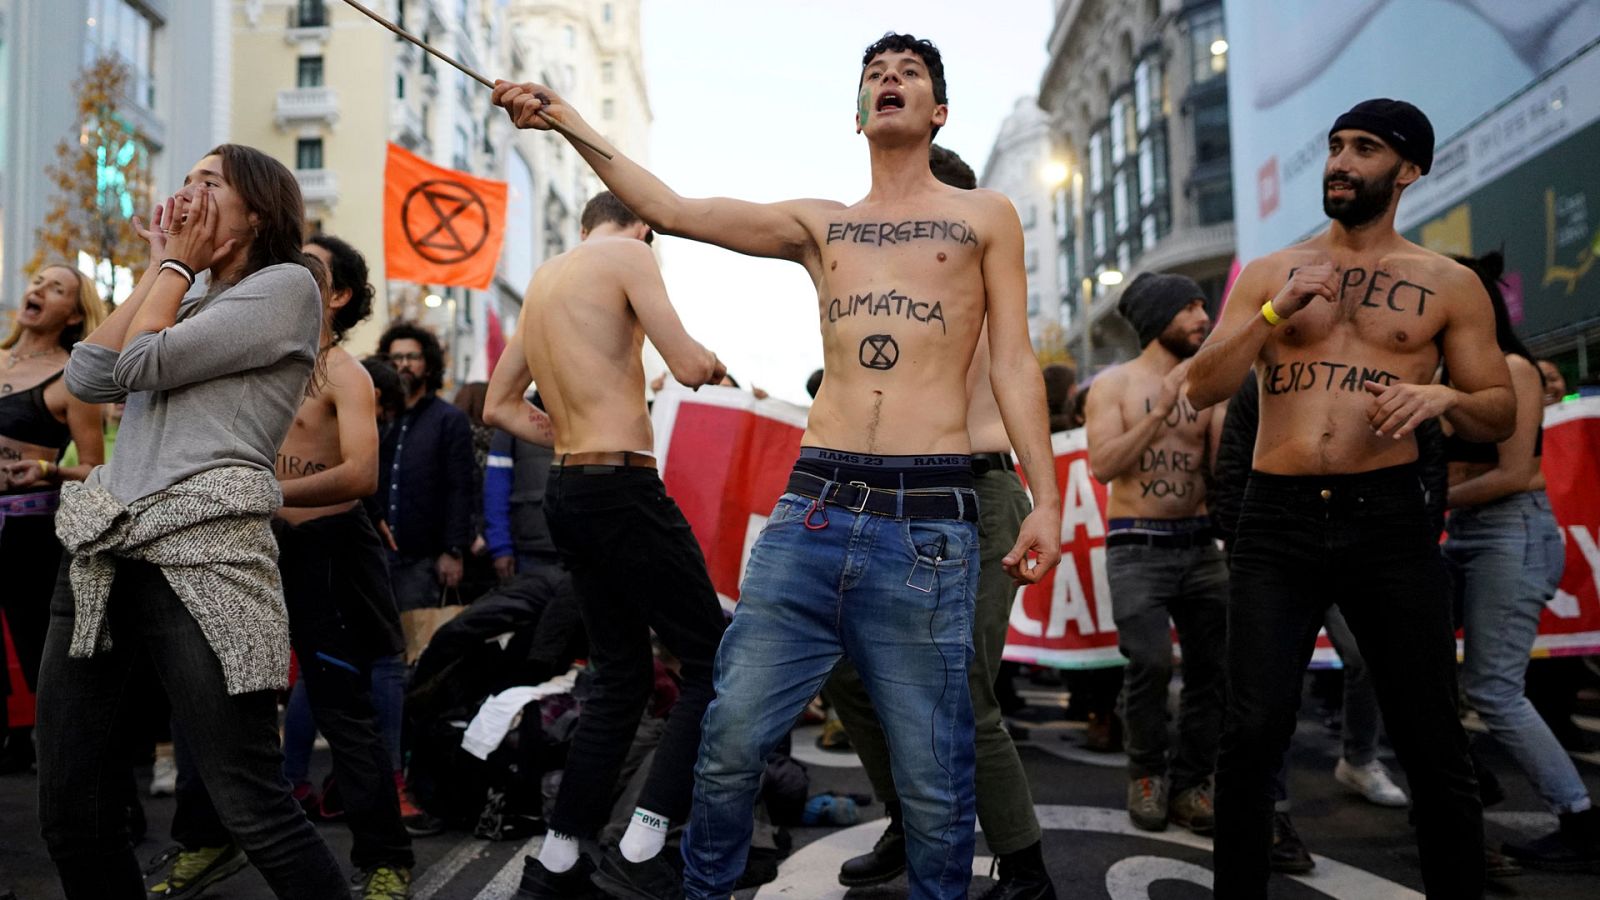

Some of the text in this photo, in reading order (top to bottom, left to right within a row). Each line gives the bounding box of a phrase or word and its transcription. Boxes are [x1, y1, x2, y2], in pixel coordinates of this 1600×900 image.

[1288, 267, 1436, 316] PECT
[1145, 397, 1199, 428] OW
[819, 450, 884, 466] RAMS 23
[914, 457, 959, 466] RAMS
[1139, 448, 1195, 472] DARE
